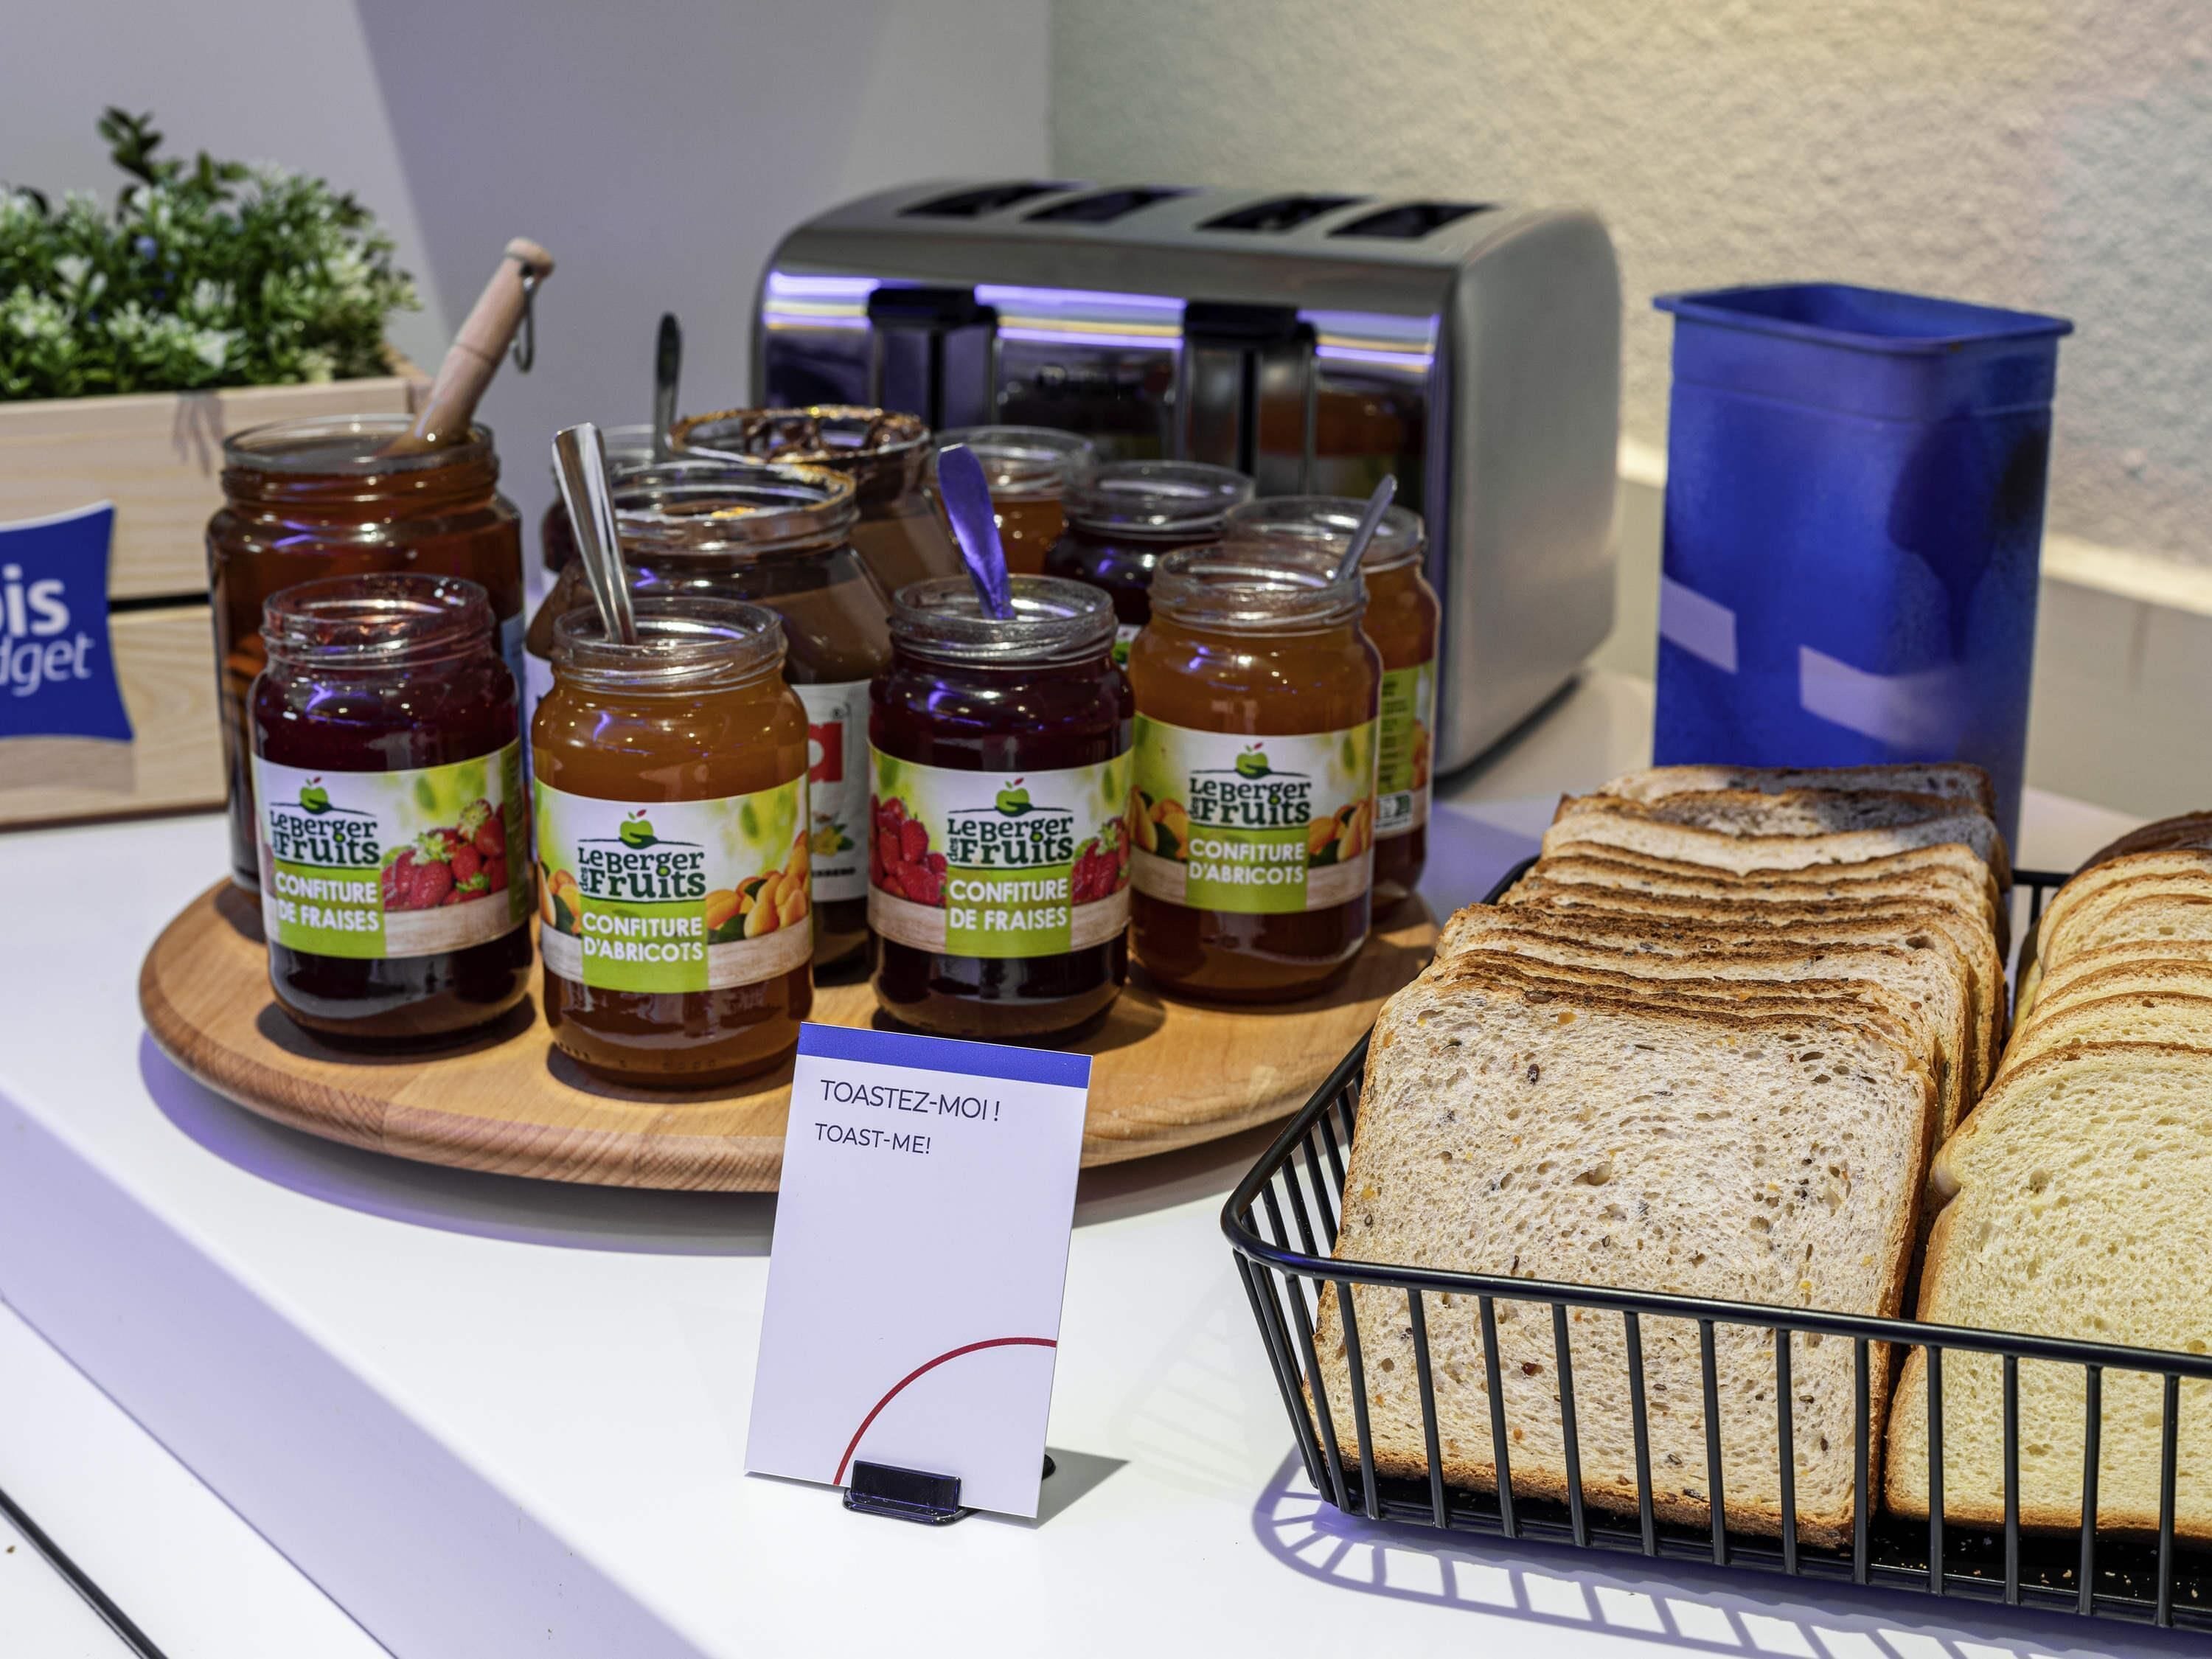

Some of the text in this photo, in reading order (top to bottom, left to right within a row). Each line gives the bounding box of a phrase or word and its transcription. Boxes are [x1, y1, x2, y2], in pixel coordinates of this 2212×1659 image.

[0, 563, 70, 636] is
[1219, 781, 1311, 804] Berger
[1200, 798, 1310, 825] Fruits
[978, 816, 1074, 843] Berger
[278, 830, 380, 865] Fruits
[959, 836, 1074, 864] Fruits
[1189, 838, 1305, 862] CONFITURE
[605, 851, 705, 877] Berger
[1189, 860, 1304, 885] D'ABRICOTS
[275, 871, 378, 903] CONFITURE
[589, 868, 706, 898] Fruits
[949, 878, 1068, 902] CONFITURE
[277, 899, 380, 932] DE FRAISES
[582, 912, 703, 937] CONFITURE
[950, 906, 1067, 931] DE FRAISES
[584, 936, 703, 962] D'ABRICOTS
[815, 1123, 931, 1154] TOAST-ME!
